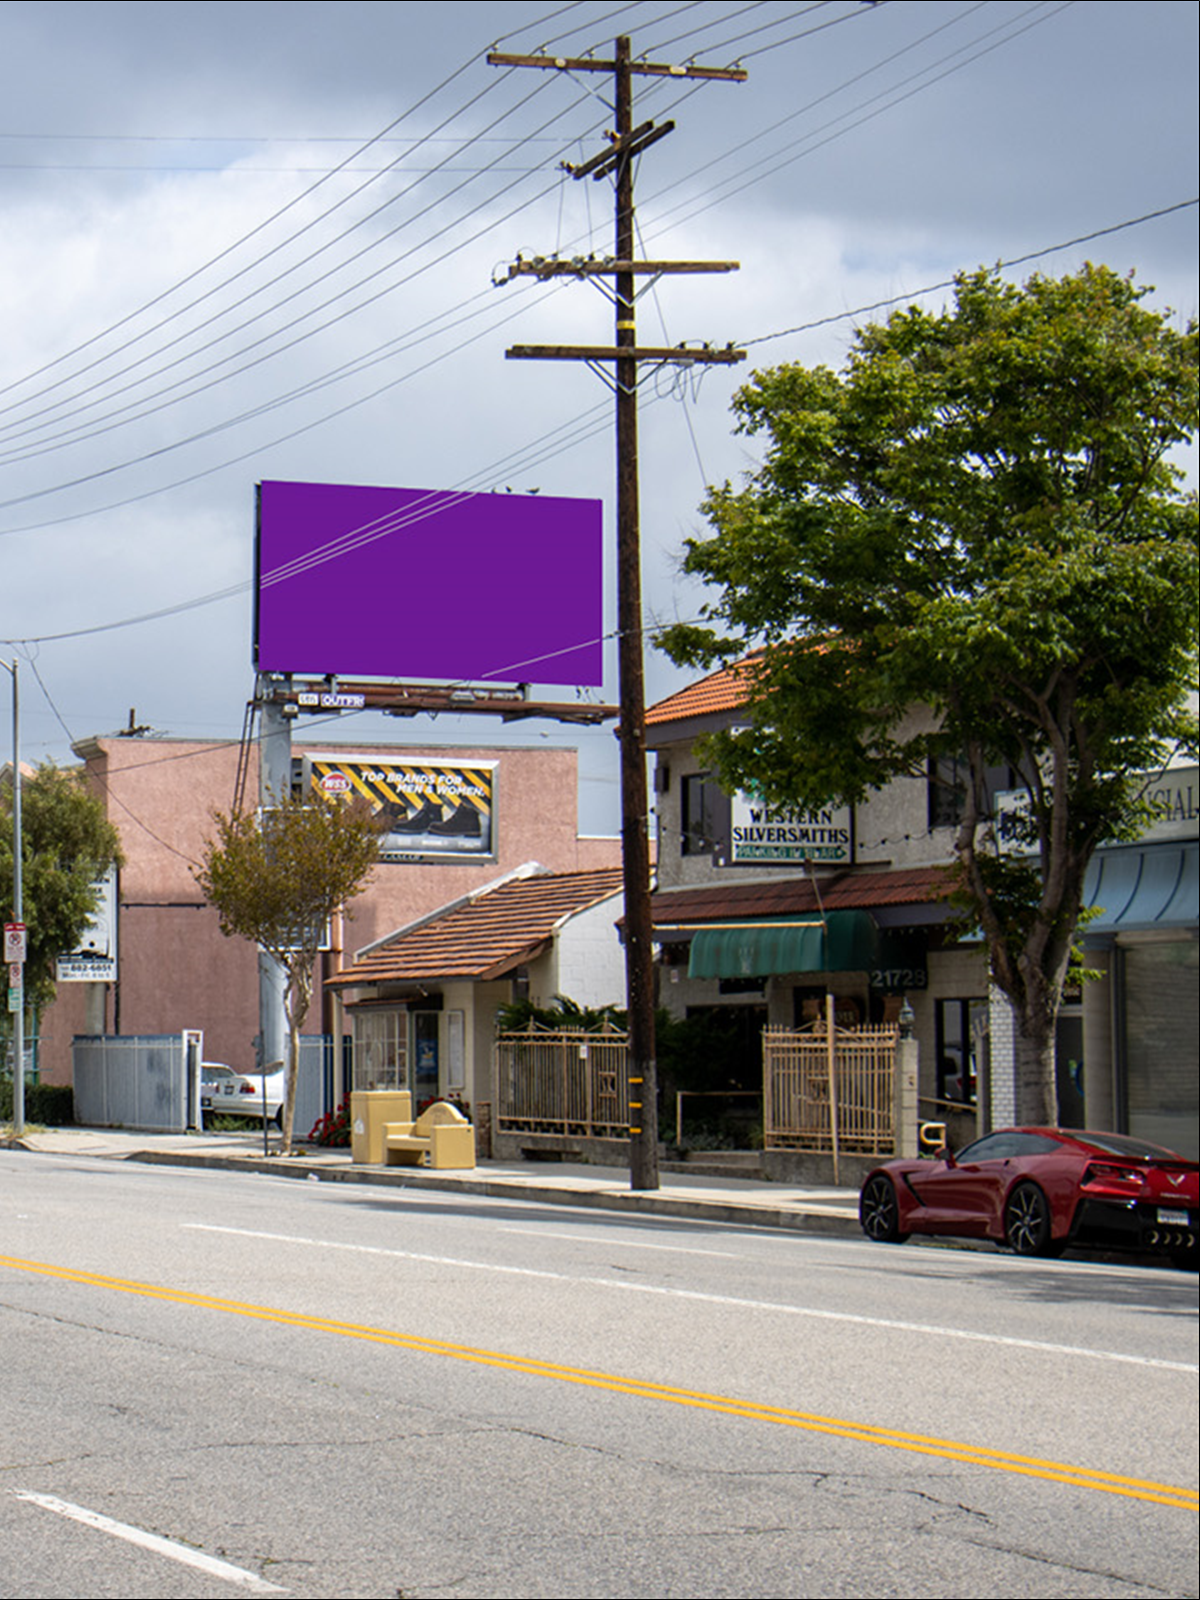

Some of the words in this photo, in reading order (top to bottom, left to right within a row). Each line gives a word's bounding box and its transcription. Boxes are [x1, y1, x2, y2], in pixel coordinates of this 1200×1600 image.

[324, 778, 347, 789] WSS
[361, 771, 385, 782] TOP
[387, 773, 435, 785] BRANDS
[438, 775, 463, 785] FOR
[396, 783, 423, 794] MEN
[426, 785, 433, 794] &
[437, 785, 485, 796] WOMEN.
[750, 808, 832, 824] WESTERN
[733, 827, 849, 843] SILVERSMITHS
[737, 846, 788, 858] PARKING
[871, 969, 926, 987] 21728
